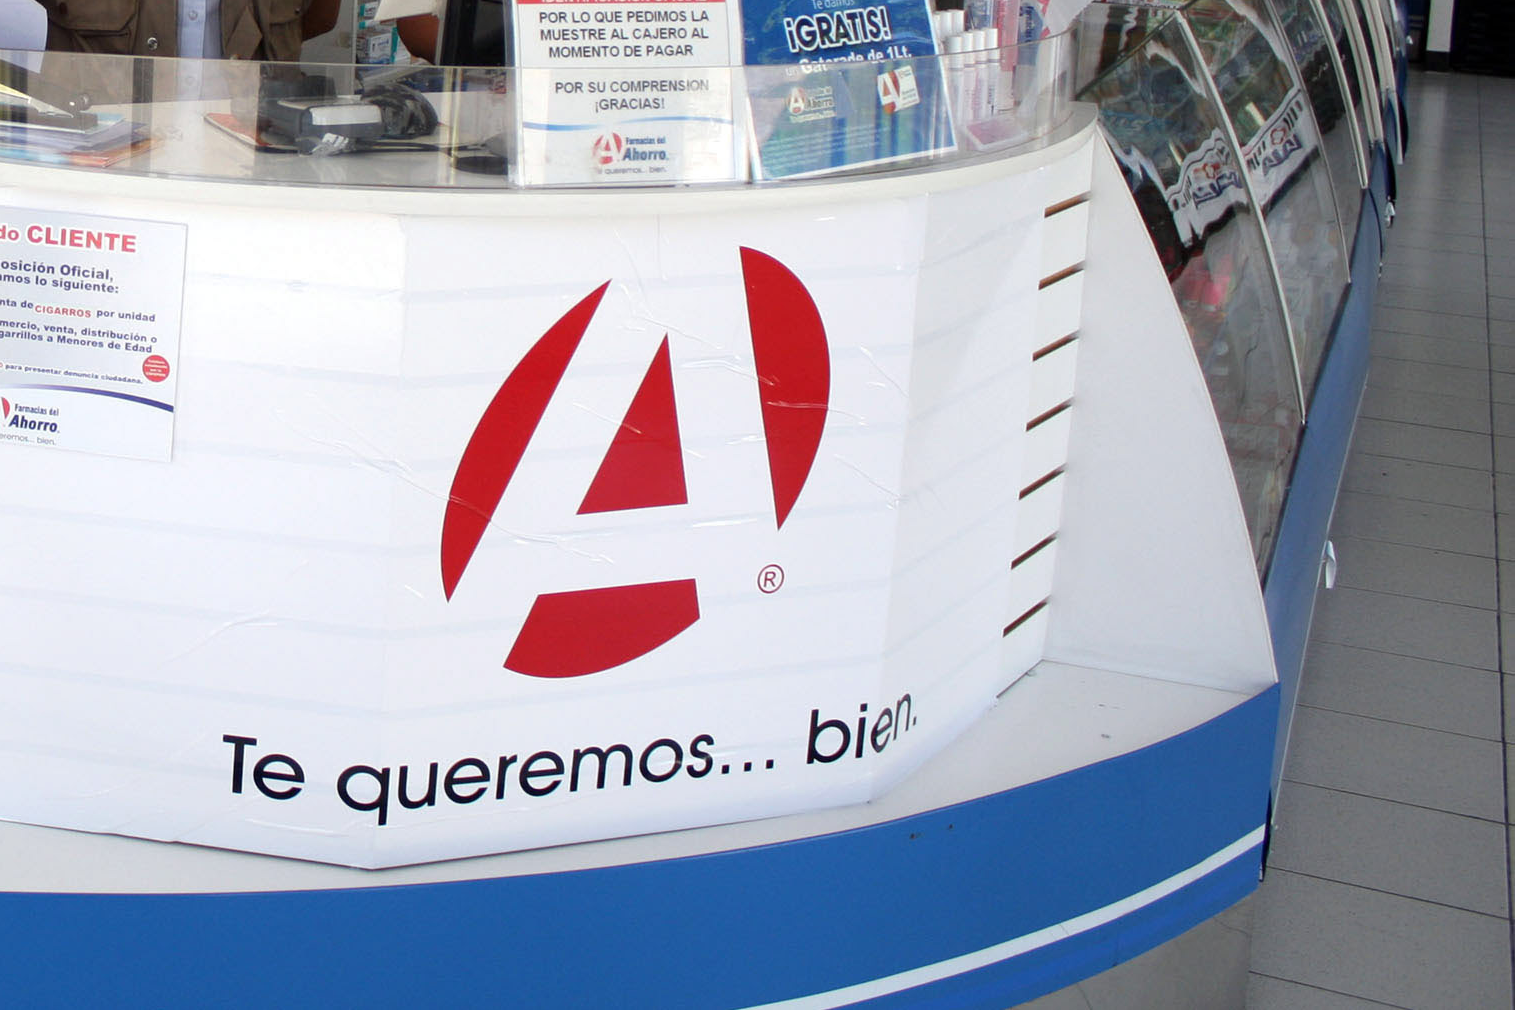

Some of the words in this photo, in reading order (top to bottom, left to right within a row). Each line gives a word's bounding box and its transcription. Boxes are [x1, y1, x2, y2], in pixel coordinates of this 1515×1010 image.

[539, 11, 567, 23] POR
[572, 11, 590, 23] LO
[594, 11, 623, 23] QUE
[627, 11, 687, 23] PEDIMOS
[691, 10, 709, 22] LA
[540, 29, 606, 41] MUESTRE
[611, 28, 628, 40] AL
[633, 28, 688, 40] CAJERO
[691, 27, 709, 39] AL
[786, 7, 892, 52] ¡GRATIS!
[549, 46, 620, 58] MOMENTO
[624, 45, 641, 57] DE
[646, 45, 694, 57] PAGAR
[555, 81, 583, 94] POR
[588, 81, 606, 93] SU
[610, 79, 710, 92] COMPRENSION
[595, 97, 665, 112] ¡GRACIAS!
[27, 225, 137, 253] CLIENTE
[60, 264, 114, 282] Oficial,
[35, 276, 47, 287] lo
[52, 278, 119, 294] siguiente:
[20, 300, 34, 310] de
[35, 305, 92, 318] CIGARROS
[96, 310, 115, 321] por
[118, 311, 156, 323] unidad
[43, 324, 78, 336] venta,
[81, 326, 147, 344] distribución
[47, 335, 54, 343] a
[57, 335, 104, 350] Menores
[108, 339, 121, 350] de
[125, 342, 152, 354] Edad
[14, 403, 48, 416] Farmacias
[49, 407, 60, 417] del
[222, 734, 305, 802] Te
[336, 733, 775, 827] queremos...
[805, 692, 918, 766] bien.
